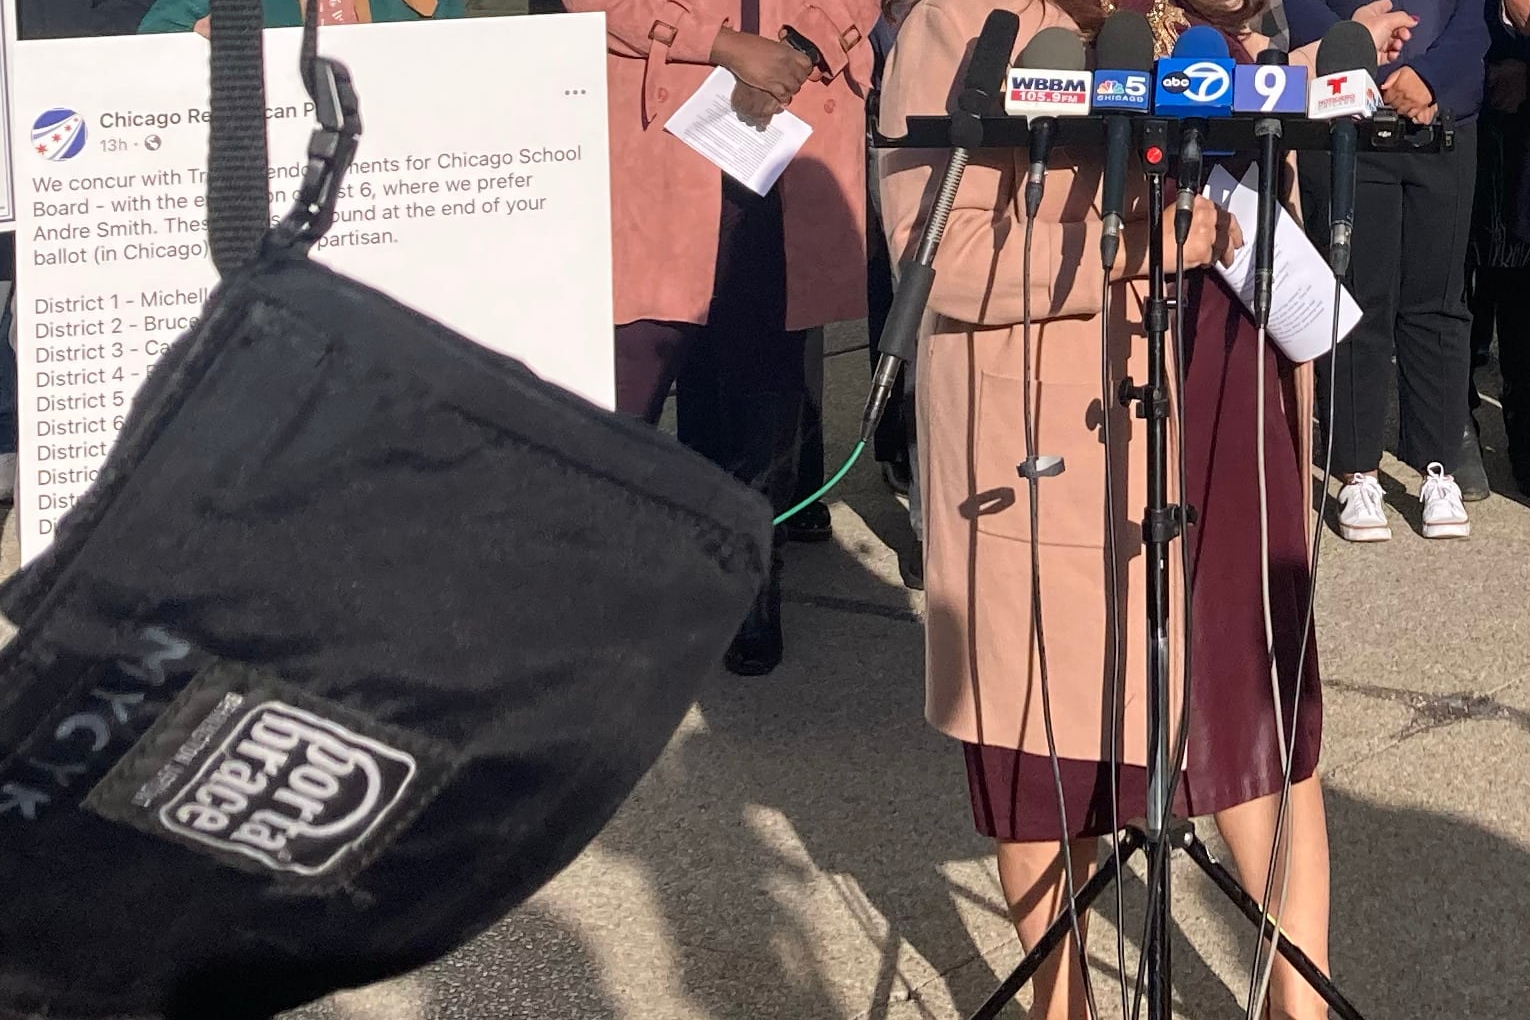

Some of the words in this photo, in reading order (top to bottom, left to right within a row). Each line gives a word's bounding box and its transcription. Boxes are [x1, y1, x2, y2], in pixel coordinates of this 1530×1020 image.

[1012, 77, 1086, 92] WBBM
[1125, 76, 1147, 96] 5
[1162, 75, 1190, 88] abc
[1185, 66, 1227, 100] 7
[1254, 65, 1287, 112] 9
[100, 109, 181, 130] Chicago
[100, 137, 128, 152] 13h
[33, 176, 62, 193] We
[69, 174, 136, 190] concur
[141, 169, 182, 187] with
[406, 154, 431, 172] for
[437, 151, 512, 172] Chicago
[519, 145, 582, 164] School
[33, 198, 89, 217] Board
[111, 195, 151, 212] with
[156, 193, 188, 210] the
[360, 181, 376, 200] 6,
[382, 179, 440, 197] where
[446, 179, 471, 193] we
[477, 173, 533, 197] prefer
[33, 224, 91, 242] Andre
[97, 220, 158, 238] Smith.
[382, 202, 400, 219] at
[405, 199, 435, 217] the
[441, 197, 475, 216] end
[481, 196, 501, 214] of
[505, 196, 546, 217] your
[34, 248, 88, 266] ballot
[94, 246, 117, 265] (in
[123, 241, 209, 262] Chicago)
[35, 295, 104, 315] District
[110, 293, 119, 309] 1
[35, 319, 105, 339] District
[111, 317, 123, 334] 2
[36, 343, 105, 363] District
[112, 342, 124, 358] 3
[36, 367, 106, 387] District
[112, 366, 124, 382] 4
[37, 392, 106, 412] District
[113, 391, 124, 407] 5
[37, 416, 106, 436] District
[113, 415, 124, 431] 6
[38, 441, 107, 461] District
[176, 713, 300, 831] brace
[230, 735, 358, 850] porta
